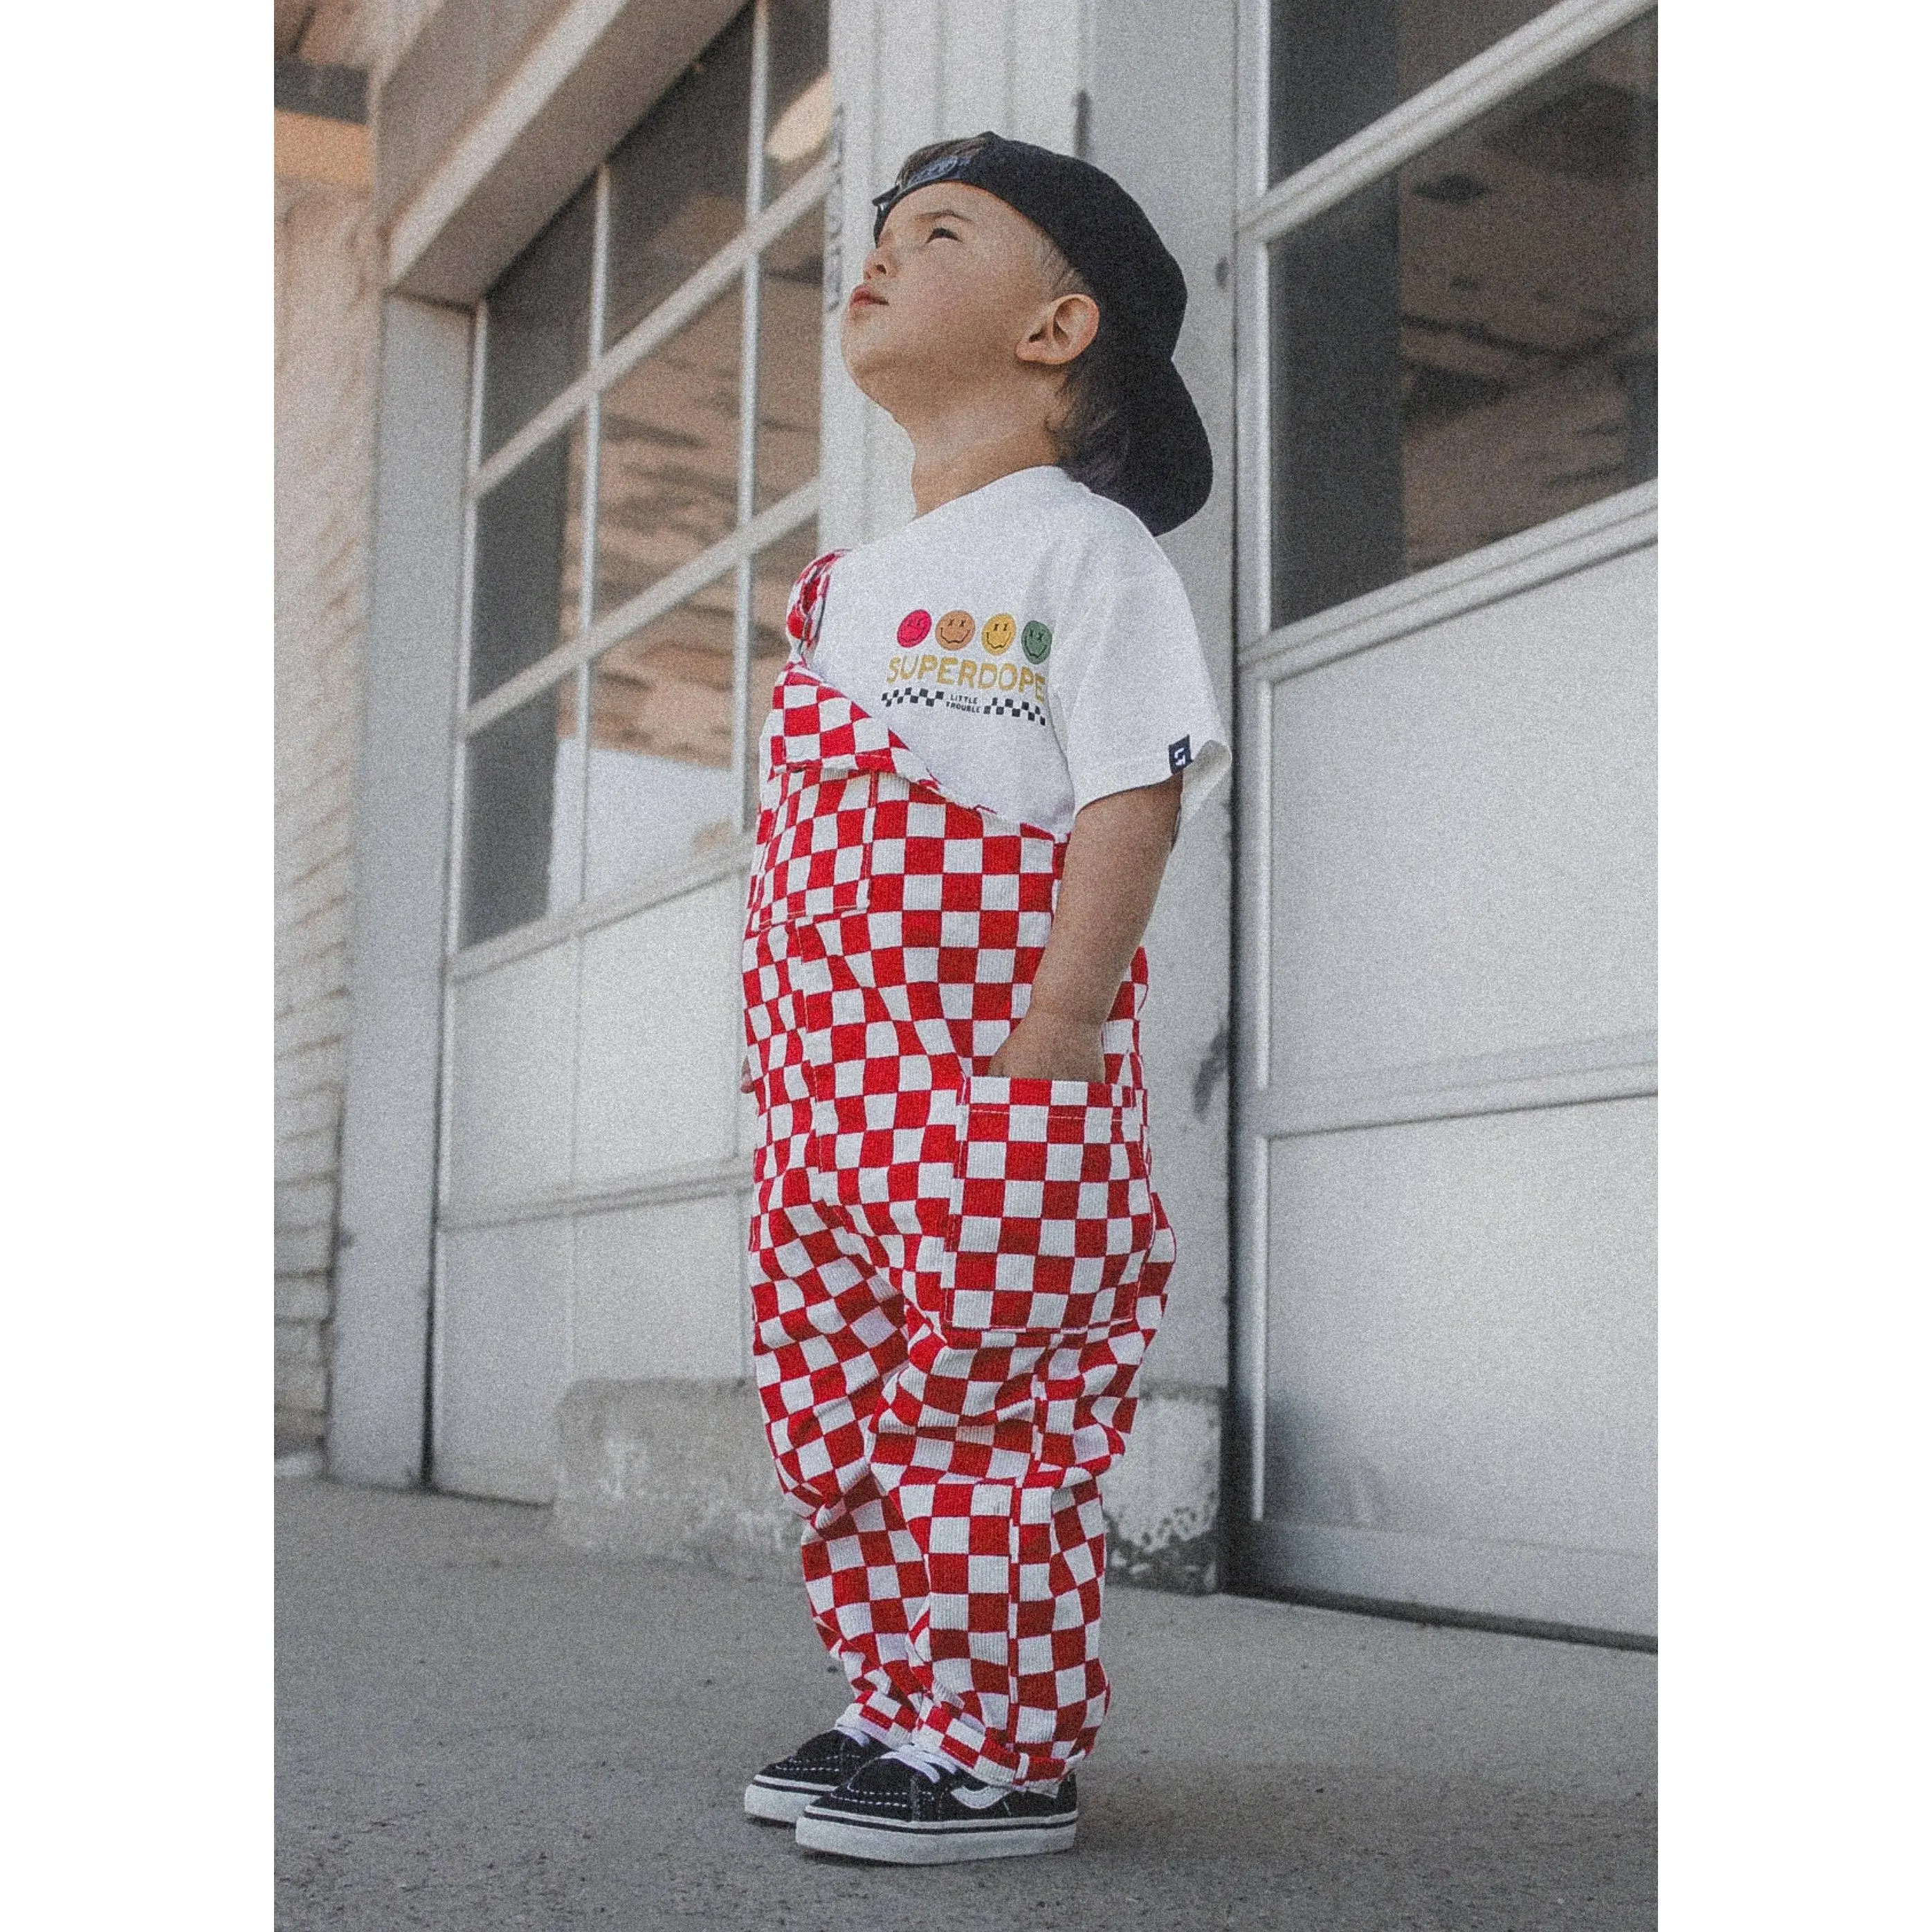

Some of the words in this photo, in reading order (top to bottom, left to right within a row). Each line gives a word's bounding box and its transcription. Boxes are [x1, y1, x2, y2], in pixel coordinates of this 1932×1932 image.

[886, 655, 1046, 702] SUPERDOPE
[950, 694, 978, 704] LITTLE
[946, 701, 981, 713] TROUBLE
